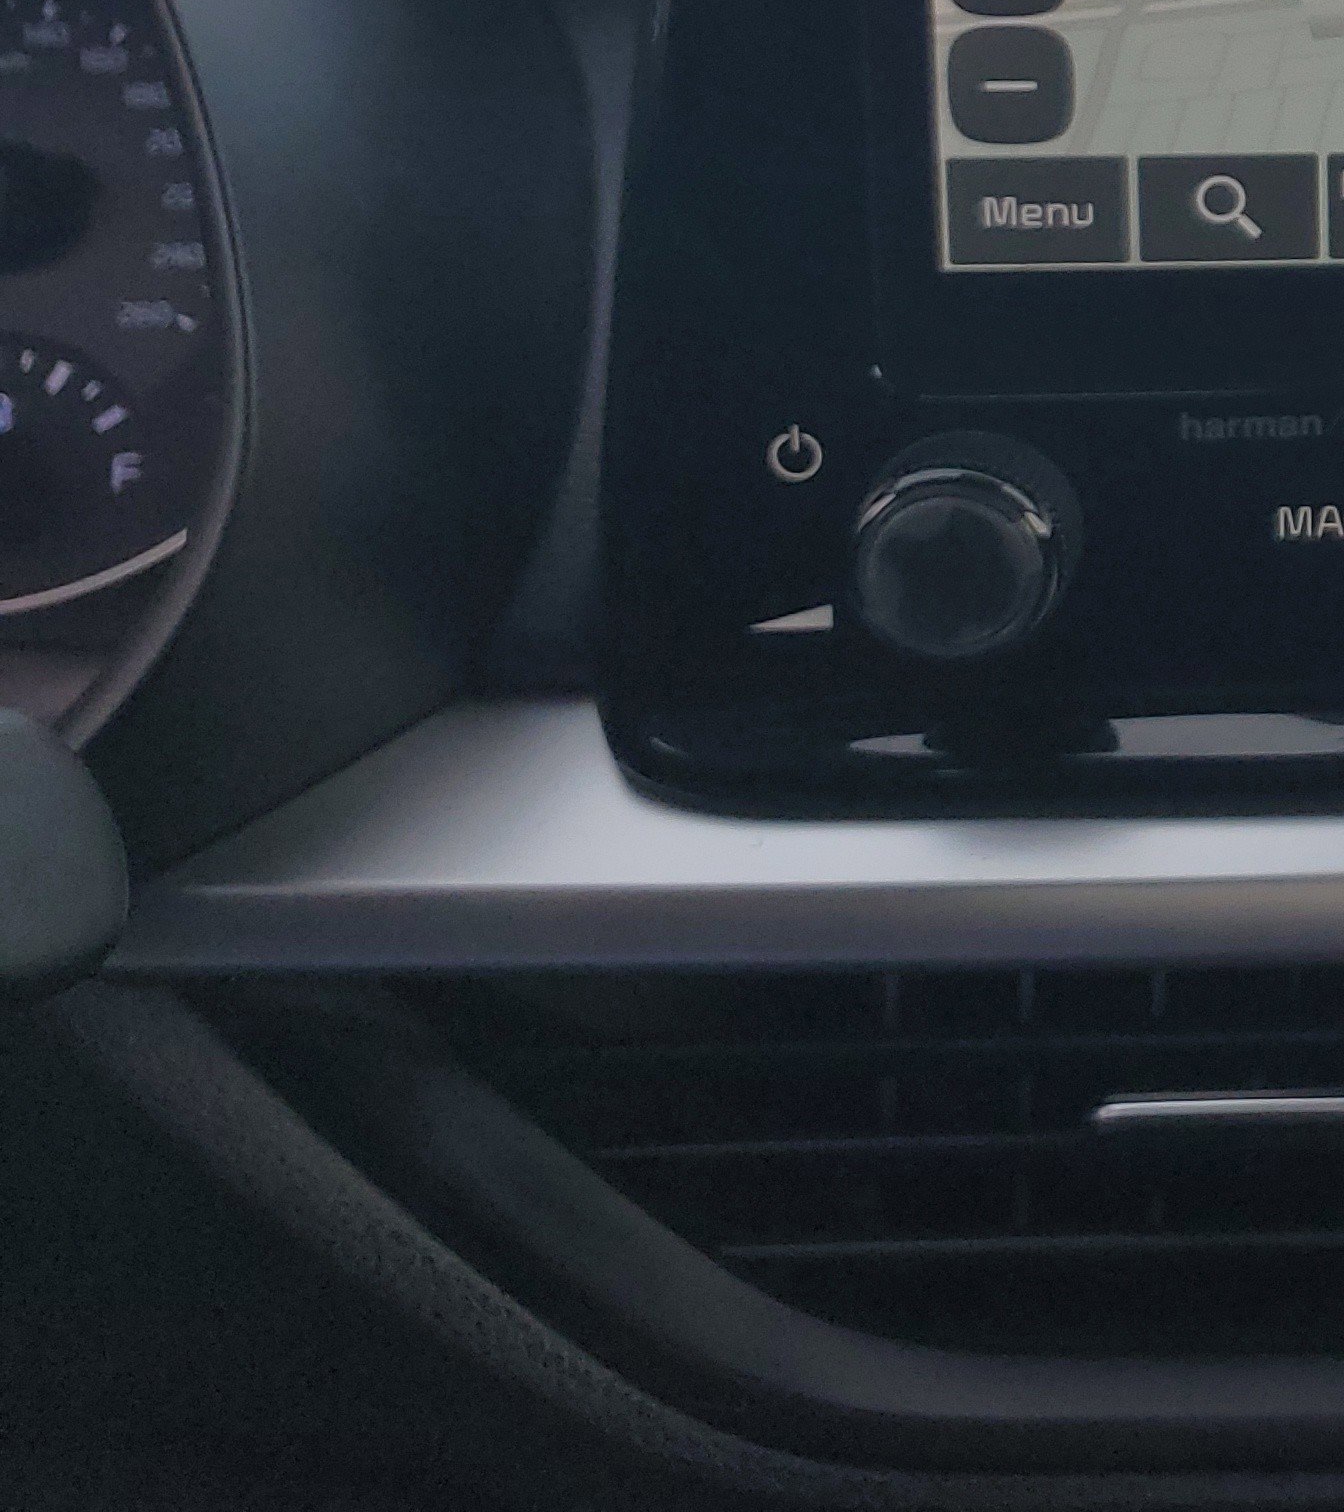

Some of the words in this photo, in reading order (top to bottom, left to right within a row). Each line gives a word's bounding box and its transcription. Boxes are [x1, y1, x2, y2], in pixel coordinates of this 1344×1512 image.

[981, 195, 1094, 229] Menu
[1180, 411, 1323, 442] harman
[111, 451, 142, 494] F
